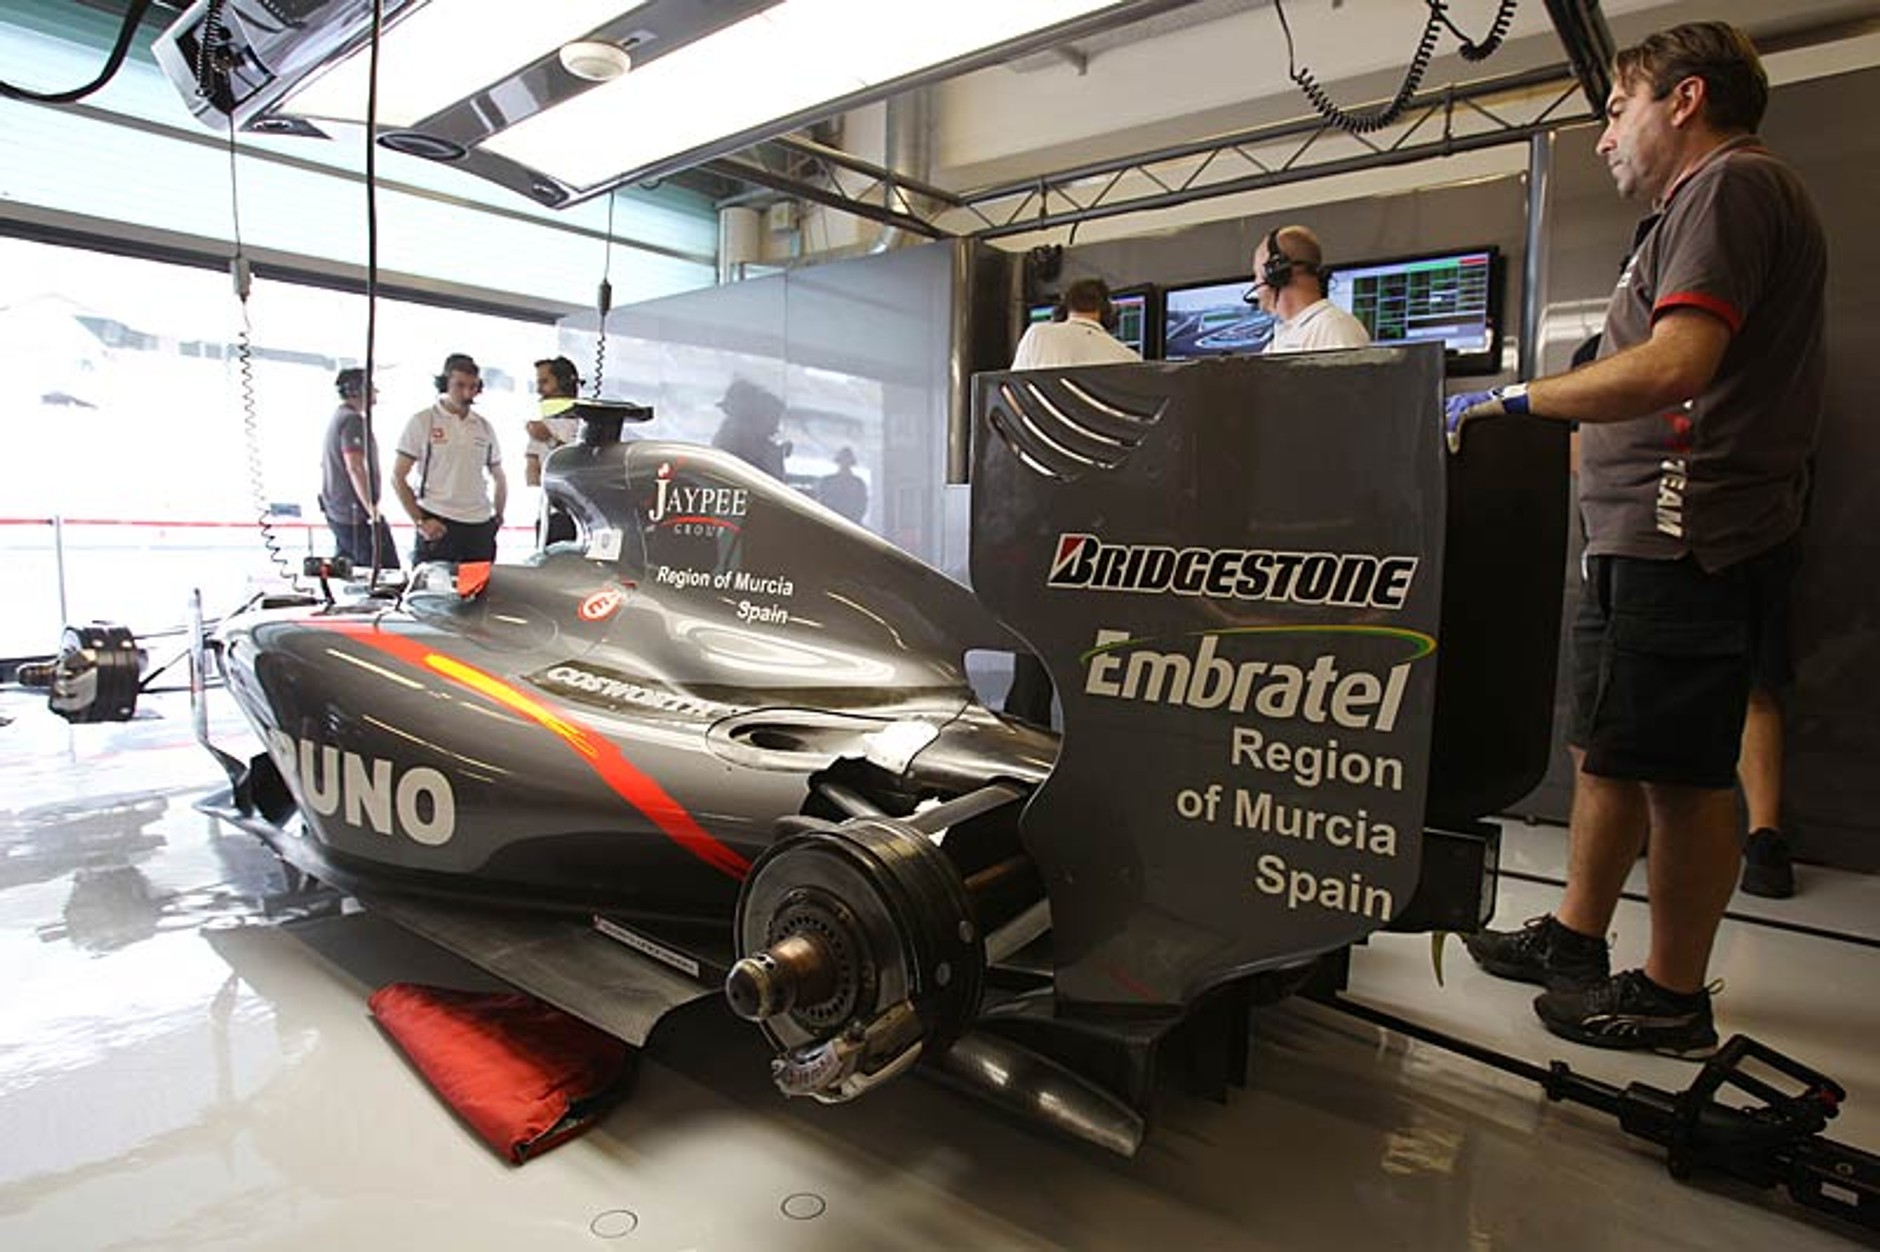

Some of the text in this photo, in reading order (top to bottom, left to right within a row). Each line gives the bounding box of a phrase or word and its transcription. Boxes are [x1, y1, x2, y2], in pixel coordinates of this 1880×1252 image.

[648, 463, 748, 522] JAYPEE
[1656, 459, 1686, 537] TEAM
[656, 565, 795, 597] Region of Murcia
[1047, 533, 1419, 609] BRIDGESTONE
[736, 600, 789, 624] Spain
[1085, 629, 1412, 732] Embratel
[1231, 726, 1403, 791] Region
[1176, 784, 1397, 857] of Murcia
[1254, 854, 1393, 922] Spain
